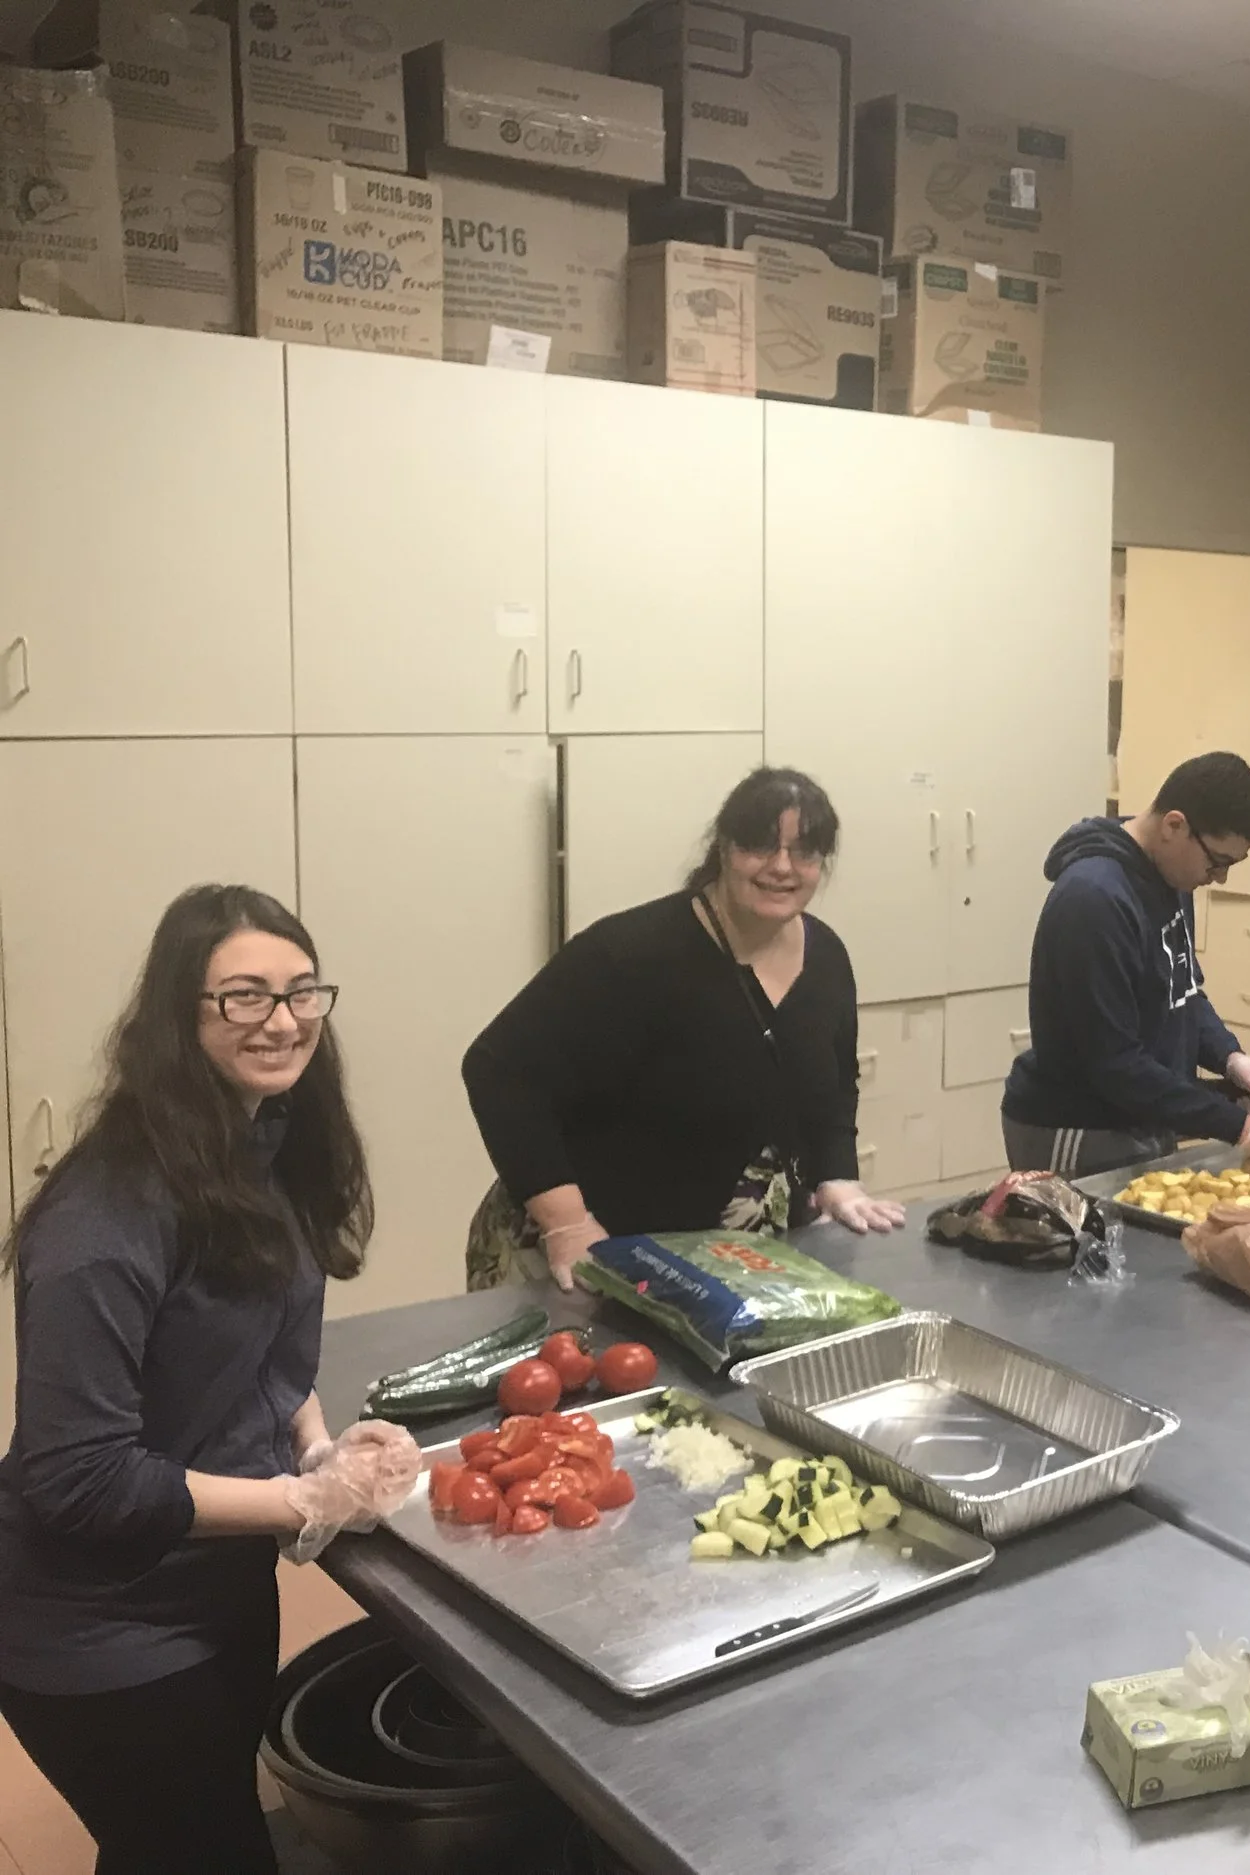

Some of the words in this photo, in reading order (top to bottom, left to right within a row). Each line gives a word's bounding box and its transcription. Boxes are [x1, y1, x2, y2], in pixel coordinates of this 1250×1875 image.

[249, 40, 293, 62] ASL2
[441, 217, 528, 257] APC16
[1190, 1750, 1234, 1769] VINY
